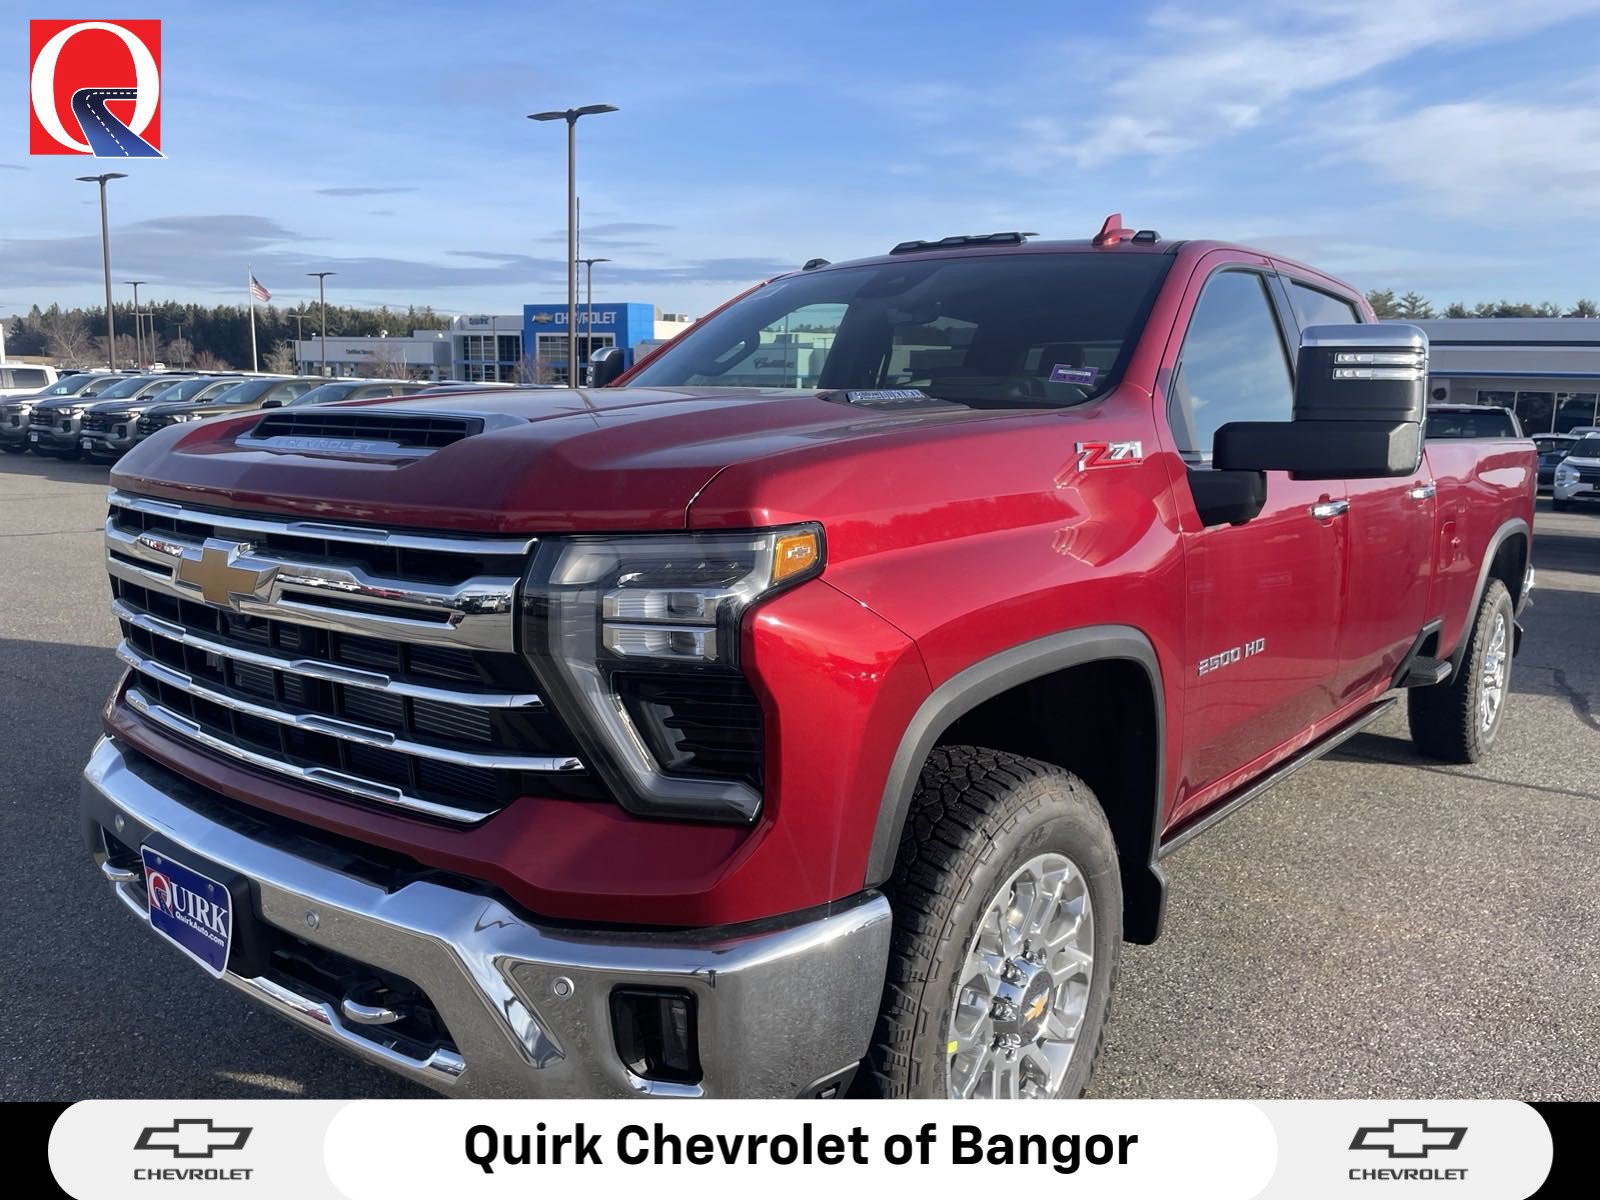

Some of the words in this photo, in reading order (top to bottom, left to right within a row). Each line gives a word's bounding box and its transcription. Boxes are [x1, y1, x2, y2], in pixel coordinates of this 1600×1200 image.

[554, 311, 617, 324] CHVROLET
[1075, 441, 1143, 472] Z71
[1198, 646, 1241, 677] 2500
[1244, 637, 1265, 658] HD
[148, 871, 228, 939] QUIRK
[175, 911, 225, 948] QuirkAuto.com
